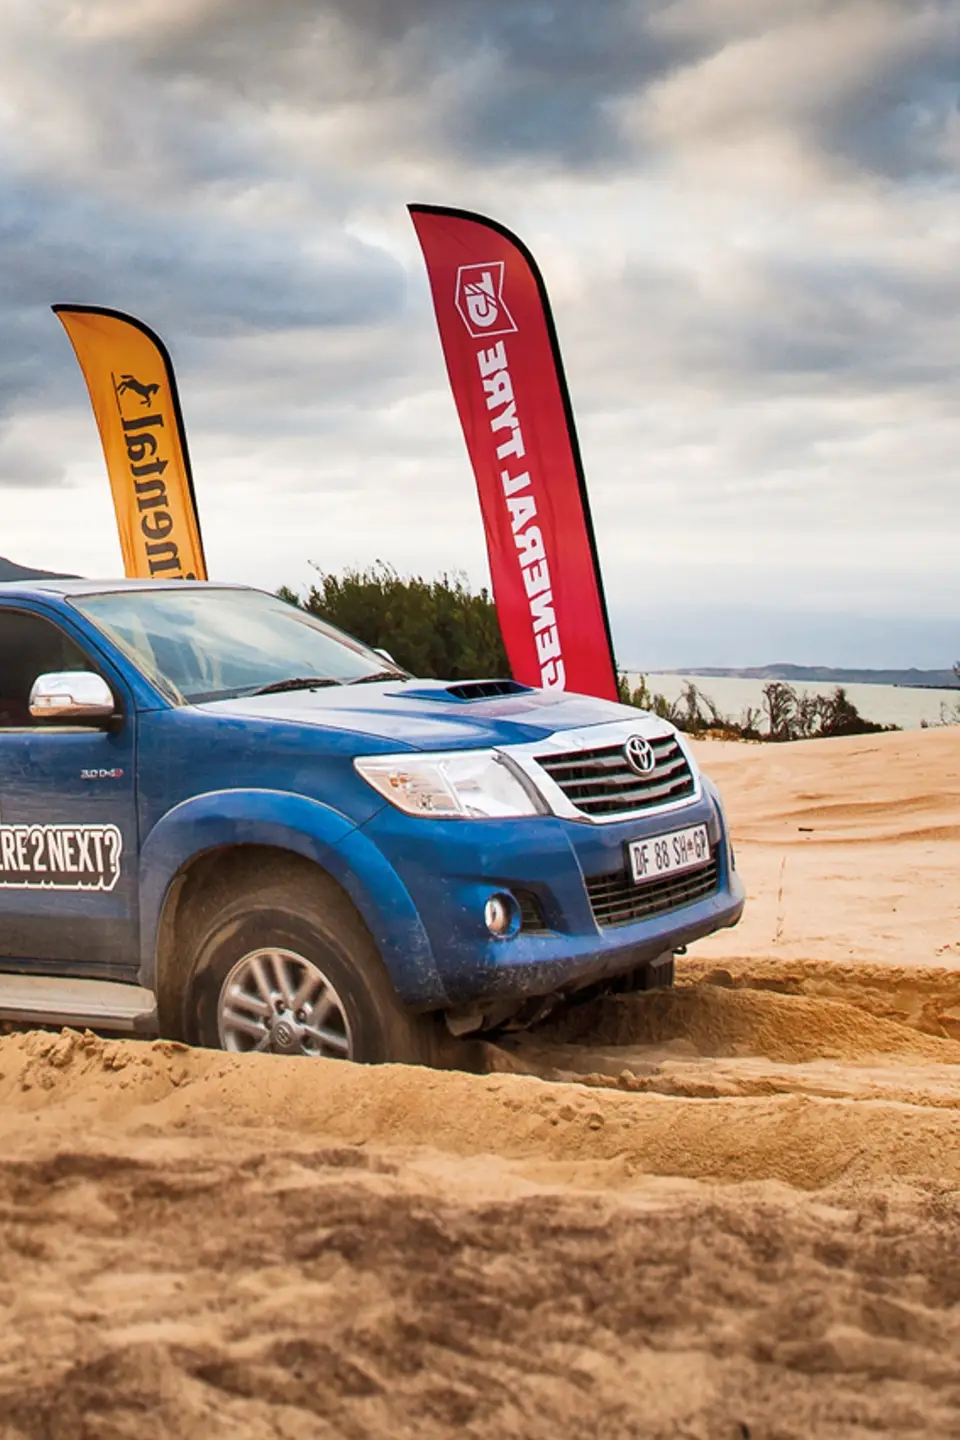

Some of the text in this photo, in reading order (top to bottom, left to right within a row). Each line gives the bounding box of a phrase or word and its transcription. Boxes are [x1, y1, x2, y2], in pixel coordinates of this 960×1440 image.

[633, 829, 706, 875] DF 88 SH GP
